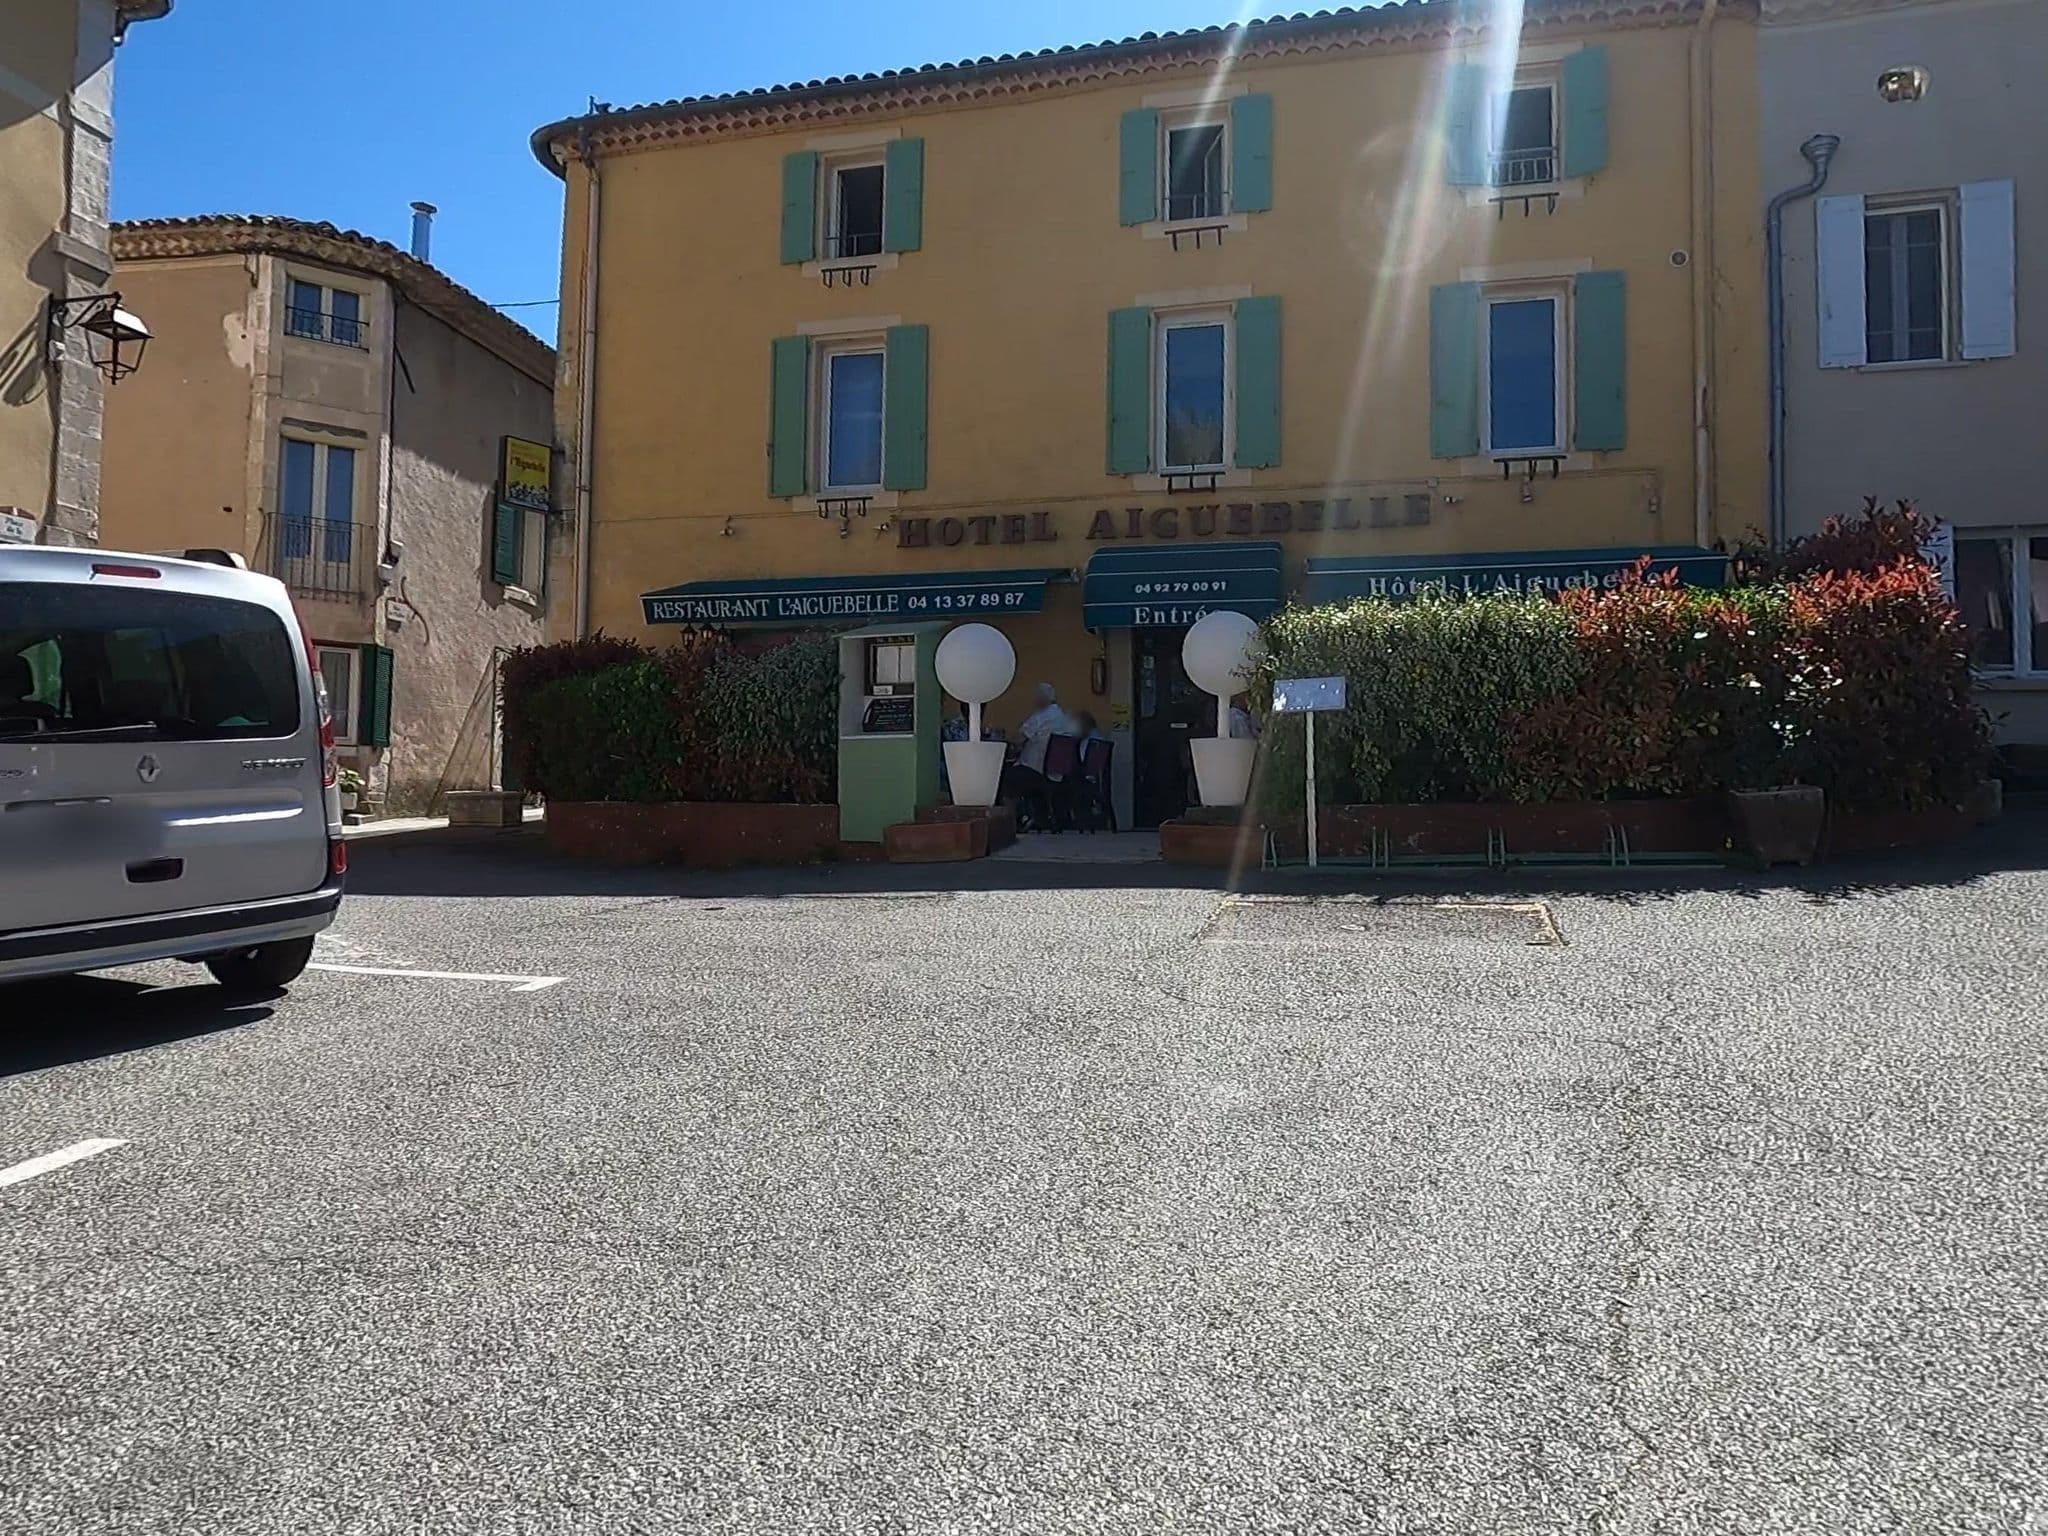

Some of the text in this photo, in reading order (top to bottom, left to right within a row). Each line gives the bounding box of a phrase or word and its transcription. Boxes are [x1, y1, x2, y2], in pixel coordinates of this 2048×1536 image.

[897, 493, 1431, 548] HOTEL AIGUEBELLE
[1134, 581, 1227, 594] 04 92 79 00 91
[653, 592, 1024, 620] RESTAURANT L'AIGUEBELLE 04 13 37 89 87
[1134, 605, 1218, 625] Entré
